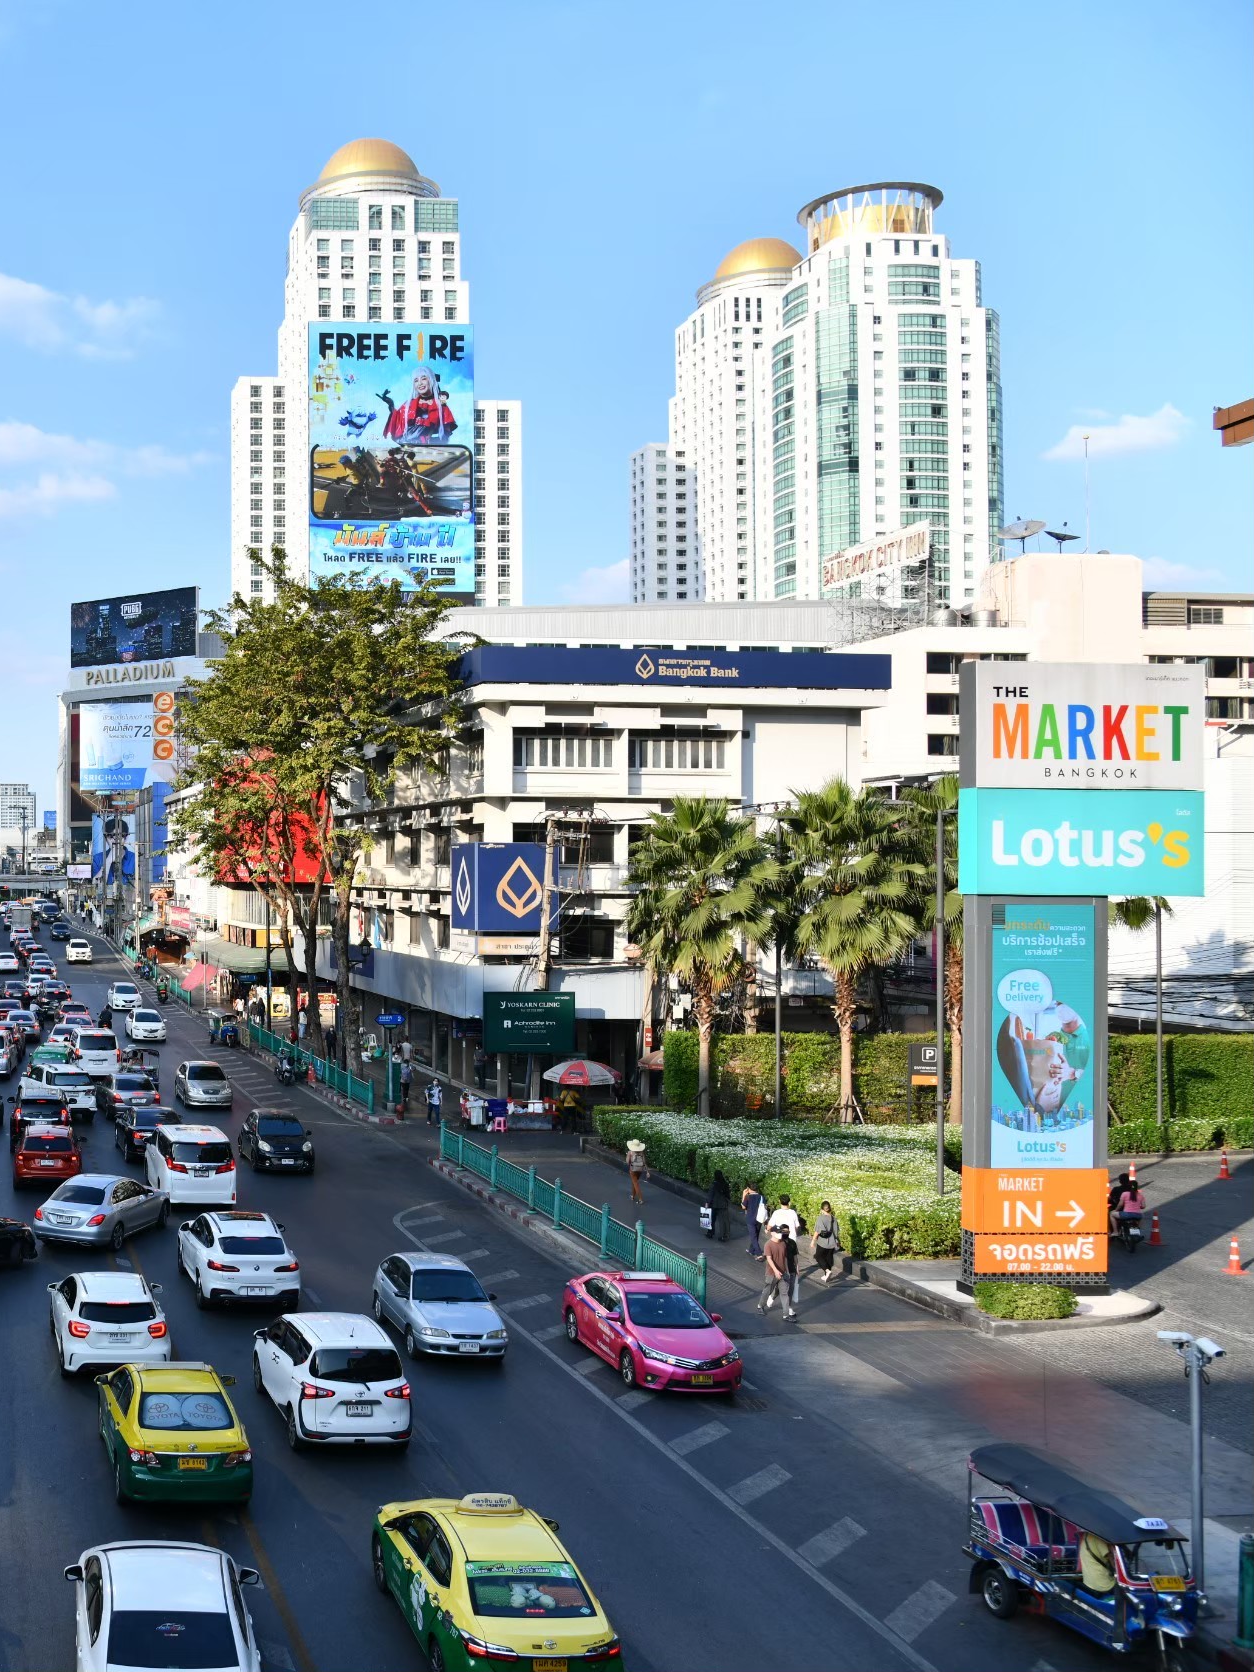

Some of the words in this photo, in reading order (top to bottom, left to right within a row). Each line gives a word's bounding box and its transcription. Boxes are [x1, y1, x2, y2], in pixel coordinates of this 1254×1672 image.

[318, 332, 388, 361] FREE
[396, 331, 465, 362] FIRE
[323, 553, 346, 562] โหลด
[349, 552, 383, 562] FREE
[407, 553, 437, 563] FIRE
[123, 604, 140, 614] PUBG
[86, 661, 175, 685] PALLADIUM
[658, 666, 708, 678] Bangkok
[710, 667, 739, 677] Bank
[992, 686, 1029, 698] THE
[133, 725, 152, 738] 72
[992, 703, 1190, 762] MARKET
[1044, 767, 1138, 779] BANGKOK
[992, 820, 1190, 868] Lotus's
[1009, 980, 1040, 992] Free
[1005, 993, 1044, 1003] Delivery
[925, 1050, 934, 1060] P
[1017, 1140, 1067, 1153] Lotus's
[998, 1177, 1044, 1192] MARKET
[1003, 1200, 1043, 1228] IN
[988, 1236, 1095, 1261] จอดรถฟรี
[1007, 1263, 1031, 1271] 07.00
[1040, 1263, 1064, 1271] 22.00
[147, 1412, 180, 1421] OYOTA
[187, 1411, 224, 1422] TOYOTA
